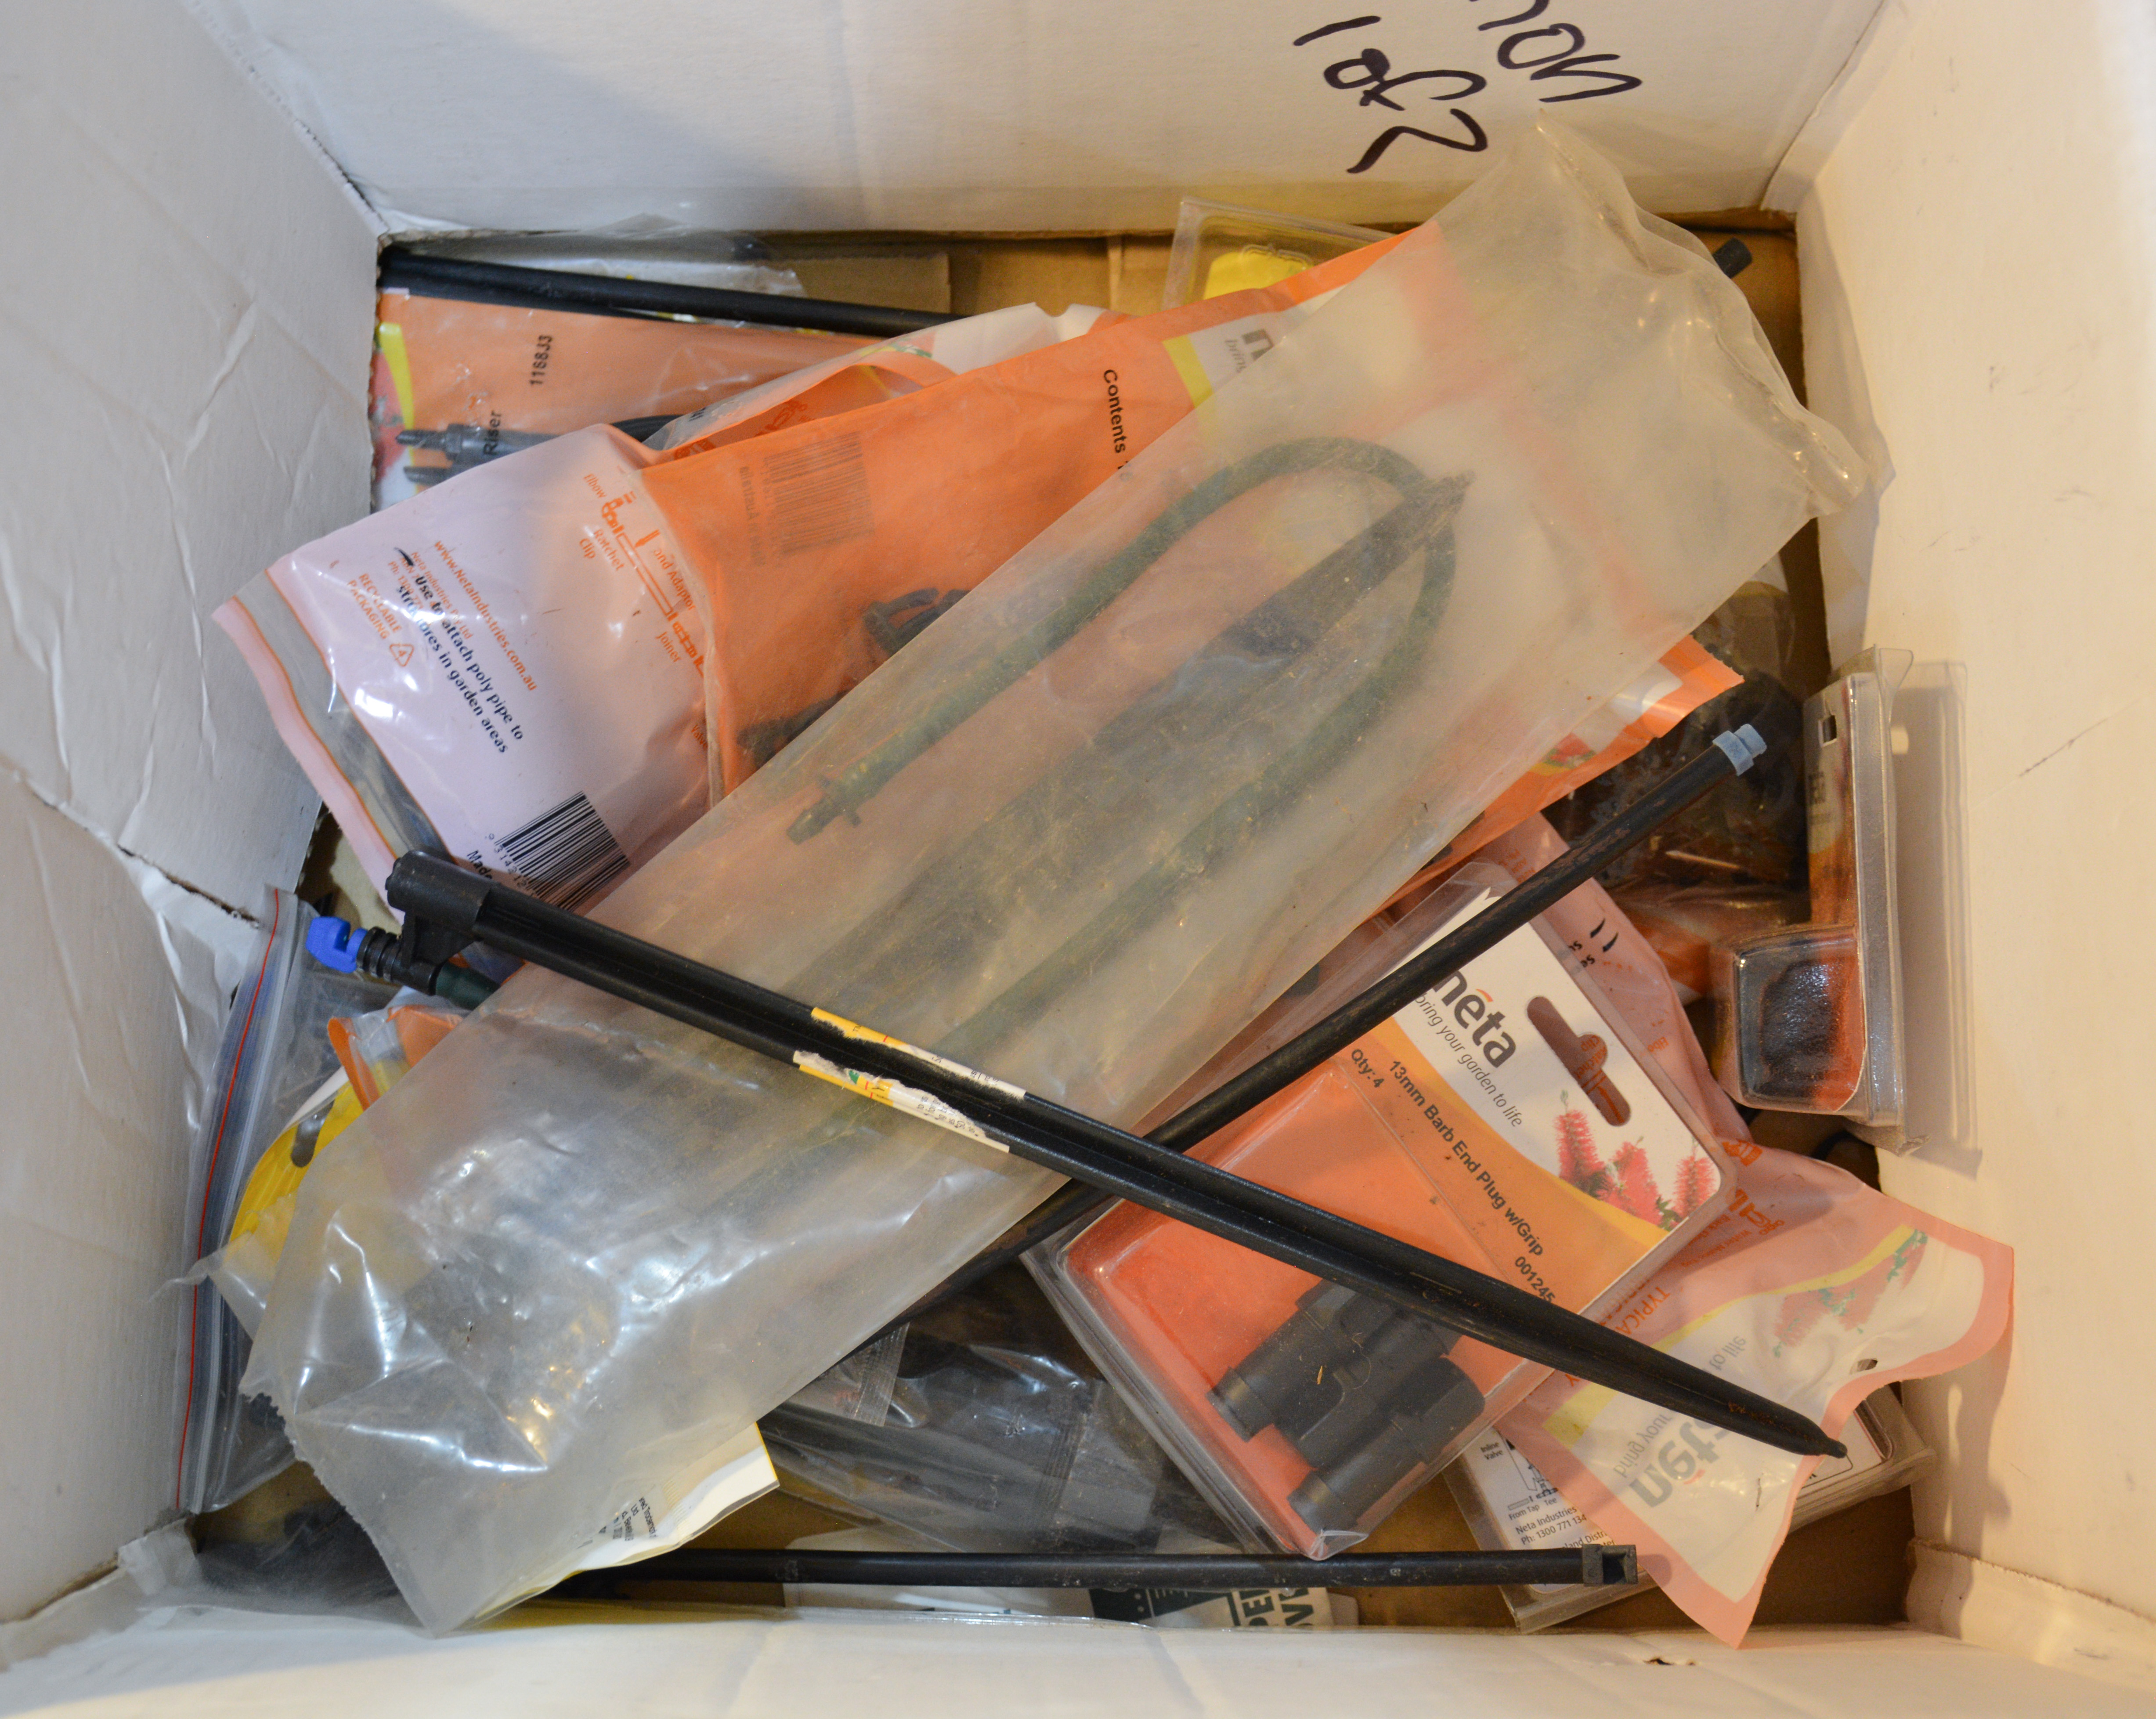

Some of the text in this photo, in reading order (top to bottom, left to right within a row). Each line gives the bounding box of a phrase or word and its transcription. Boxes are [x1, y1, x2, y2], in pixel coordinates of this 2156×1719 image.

[484, 410, 502, 455] Riser
[1103, 369, 1127, 454] Contents
[583, 473, 607, 499] Elbow
[579, 538, 596, 559] Clip
[593, 528, 625, 571] Ratchet
[411, 551, 474, 640] Neta Industries Py Ltd
[653, 548, 696, 611] and Adaptor
[347, 579, 390, 640] PACKAGING
[359, 573, 402, 633] RECYCLABLE
[434, 540, 537, 691] www.NetaIndustries.com.au
[396, 586, 508, 753] struures in garden areas
[415, 575, 434, 600] Use
[442, 619, 474, 662] attach
[466, 662, 494, 693] poly
[486, 694, 513, 724] pipe
[511, 724, 524, 740] to
[655, 631, 681, 663] Joiner
[1415, 992, 1522, 1127] bring your garden to life
[1646, 1036, 1669, 1053] Elbo
[1351, 1049, 1385, 1089] Qty: 4
[1389, 1060, 1544, 1256] 13mm Barb End Plug w/Grip
[1514, 1255, 1556, 1303] 001245
[1480, 1441, 1500, 1453] Inline
[1509, 1504, 1540, 1521] From Tap
[1515, 1505, 1578, 1535] Neta Industries
[1544, 1497, 1558, 1506] Tee
[1520, 1513, 1587, 1545] Ph: 1300 771 134
